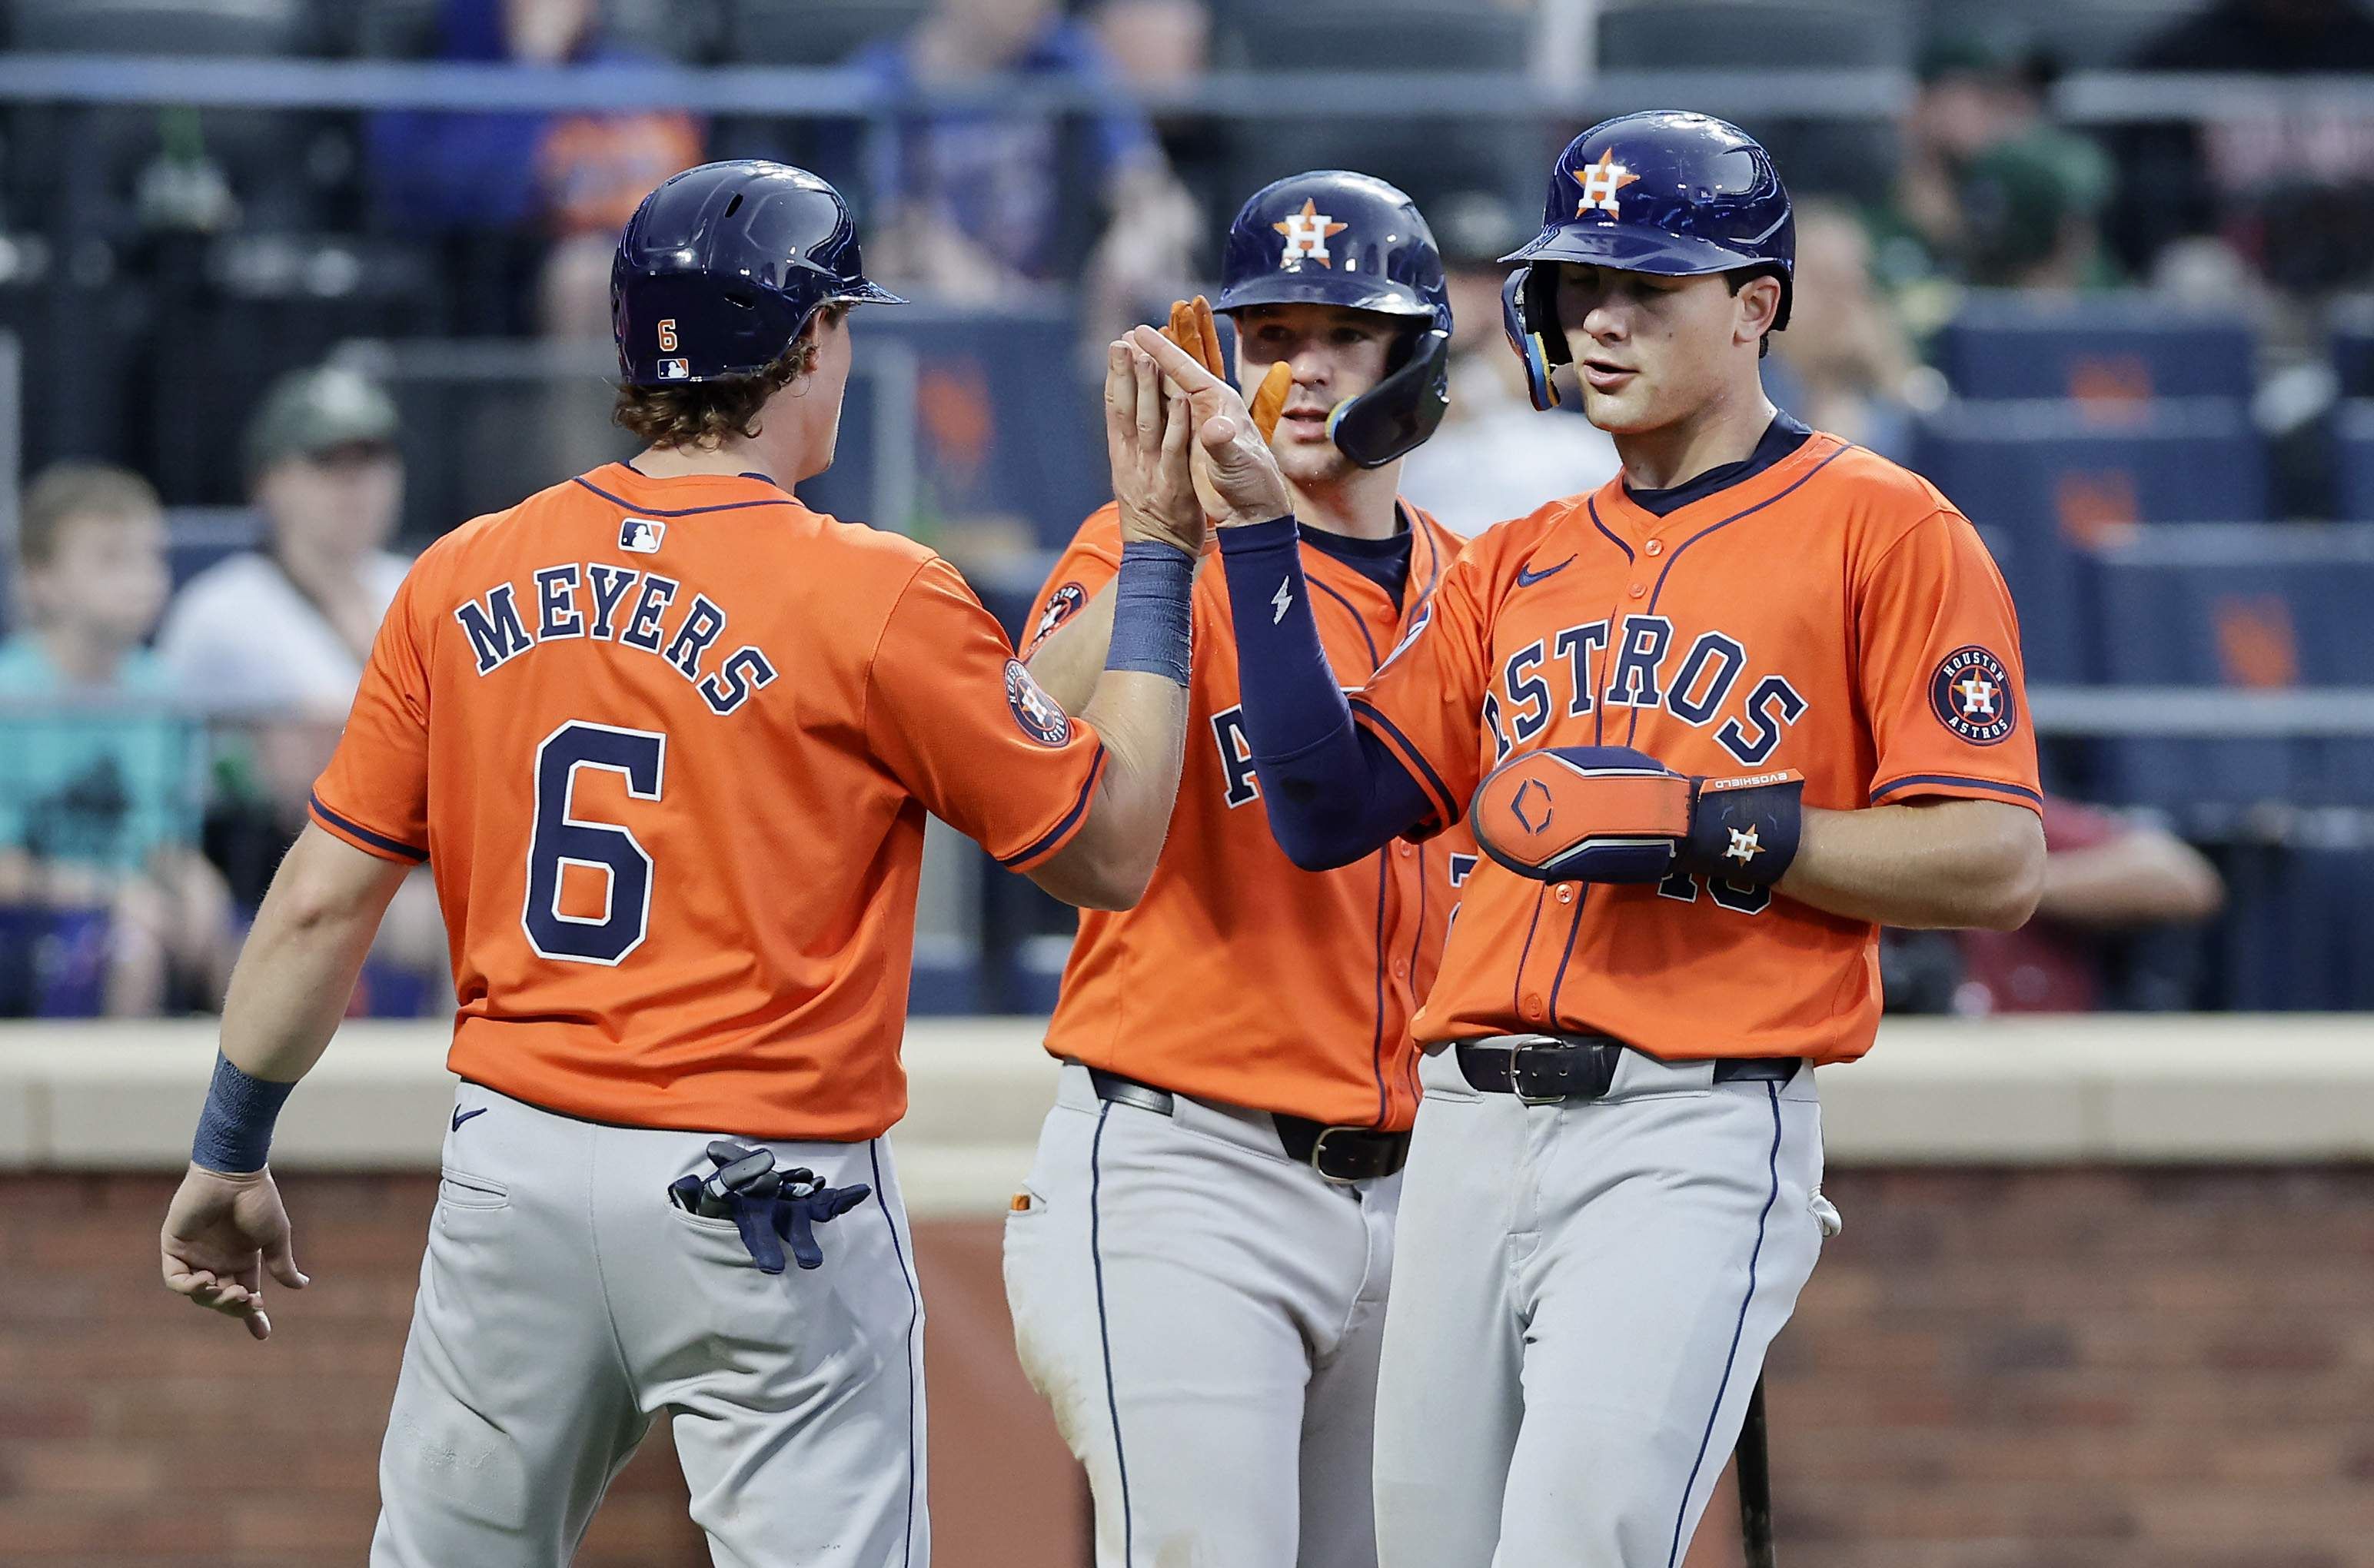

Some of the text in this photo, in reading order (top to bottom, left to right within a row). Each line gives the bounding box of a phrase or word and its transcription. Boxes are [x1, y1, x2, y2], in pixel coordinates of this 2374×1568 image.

[1578, 164, 1627, 211] H
[1283, 214, 1333, 259] H
[657, 319, 678, 352] 6
[454, 562, 780, 716] MEYERS
[1943, 652, 2006, 682] HOUSTON
[1961, 679, 1994, 713] H
[1948, 716, 2008, 739] ASTROS
[1714, 772, 1788, 789] EVOSHIELD
[520, 719, 667, 967] 6
